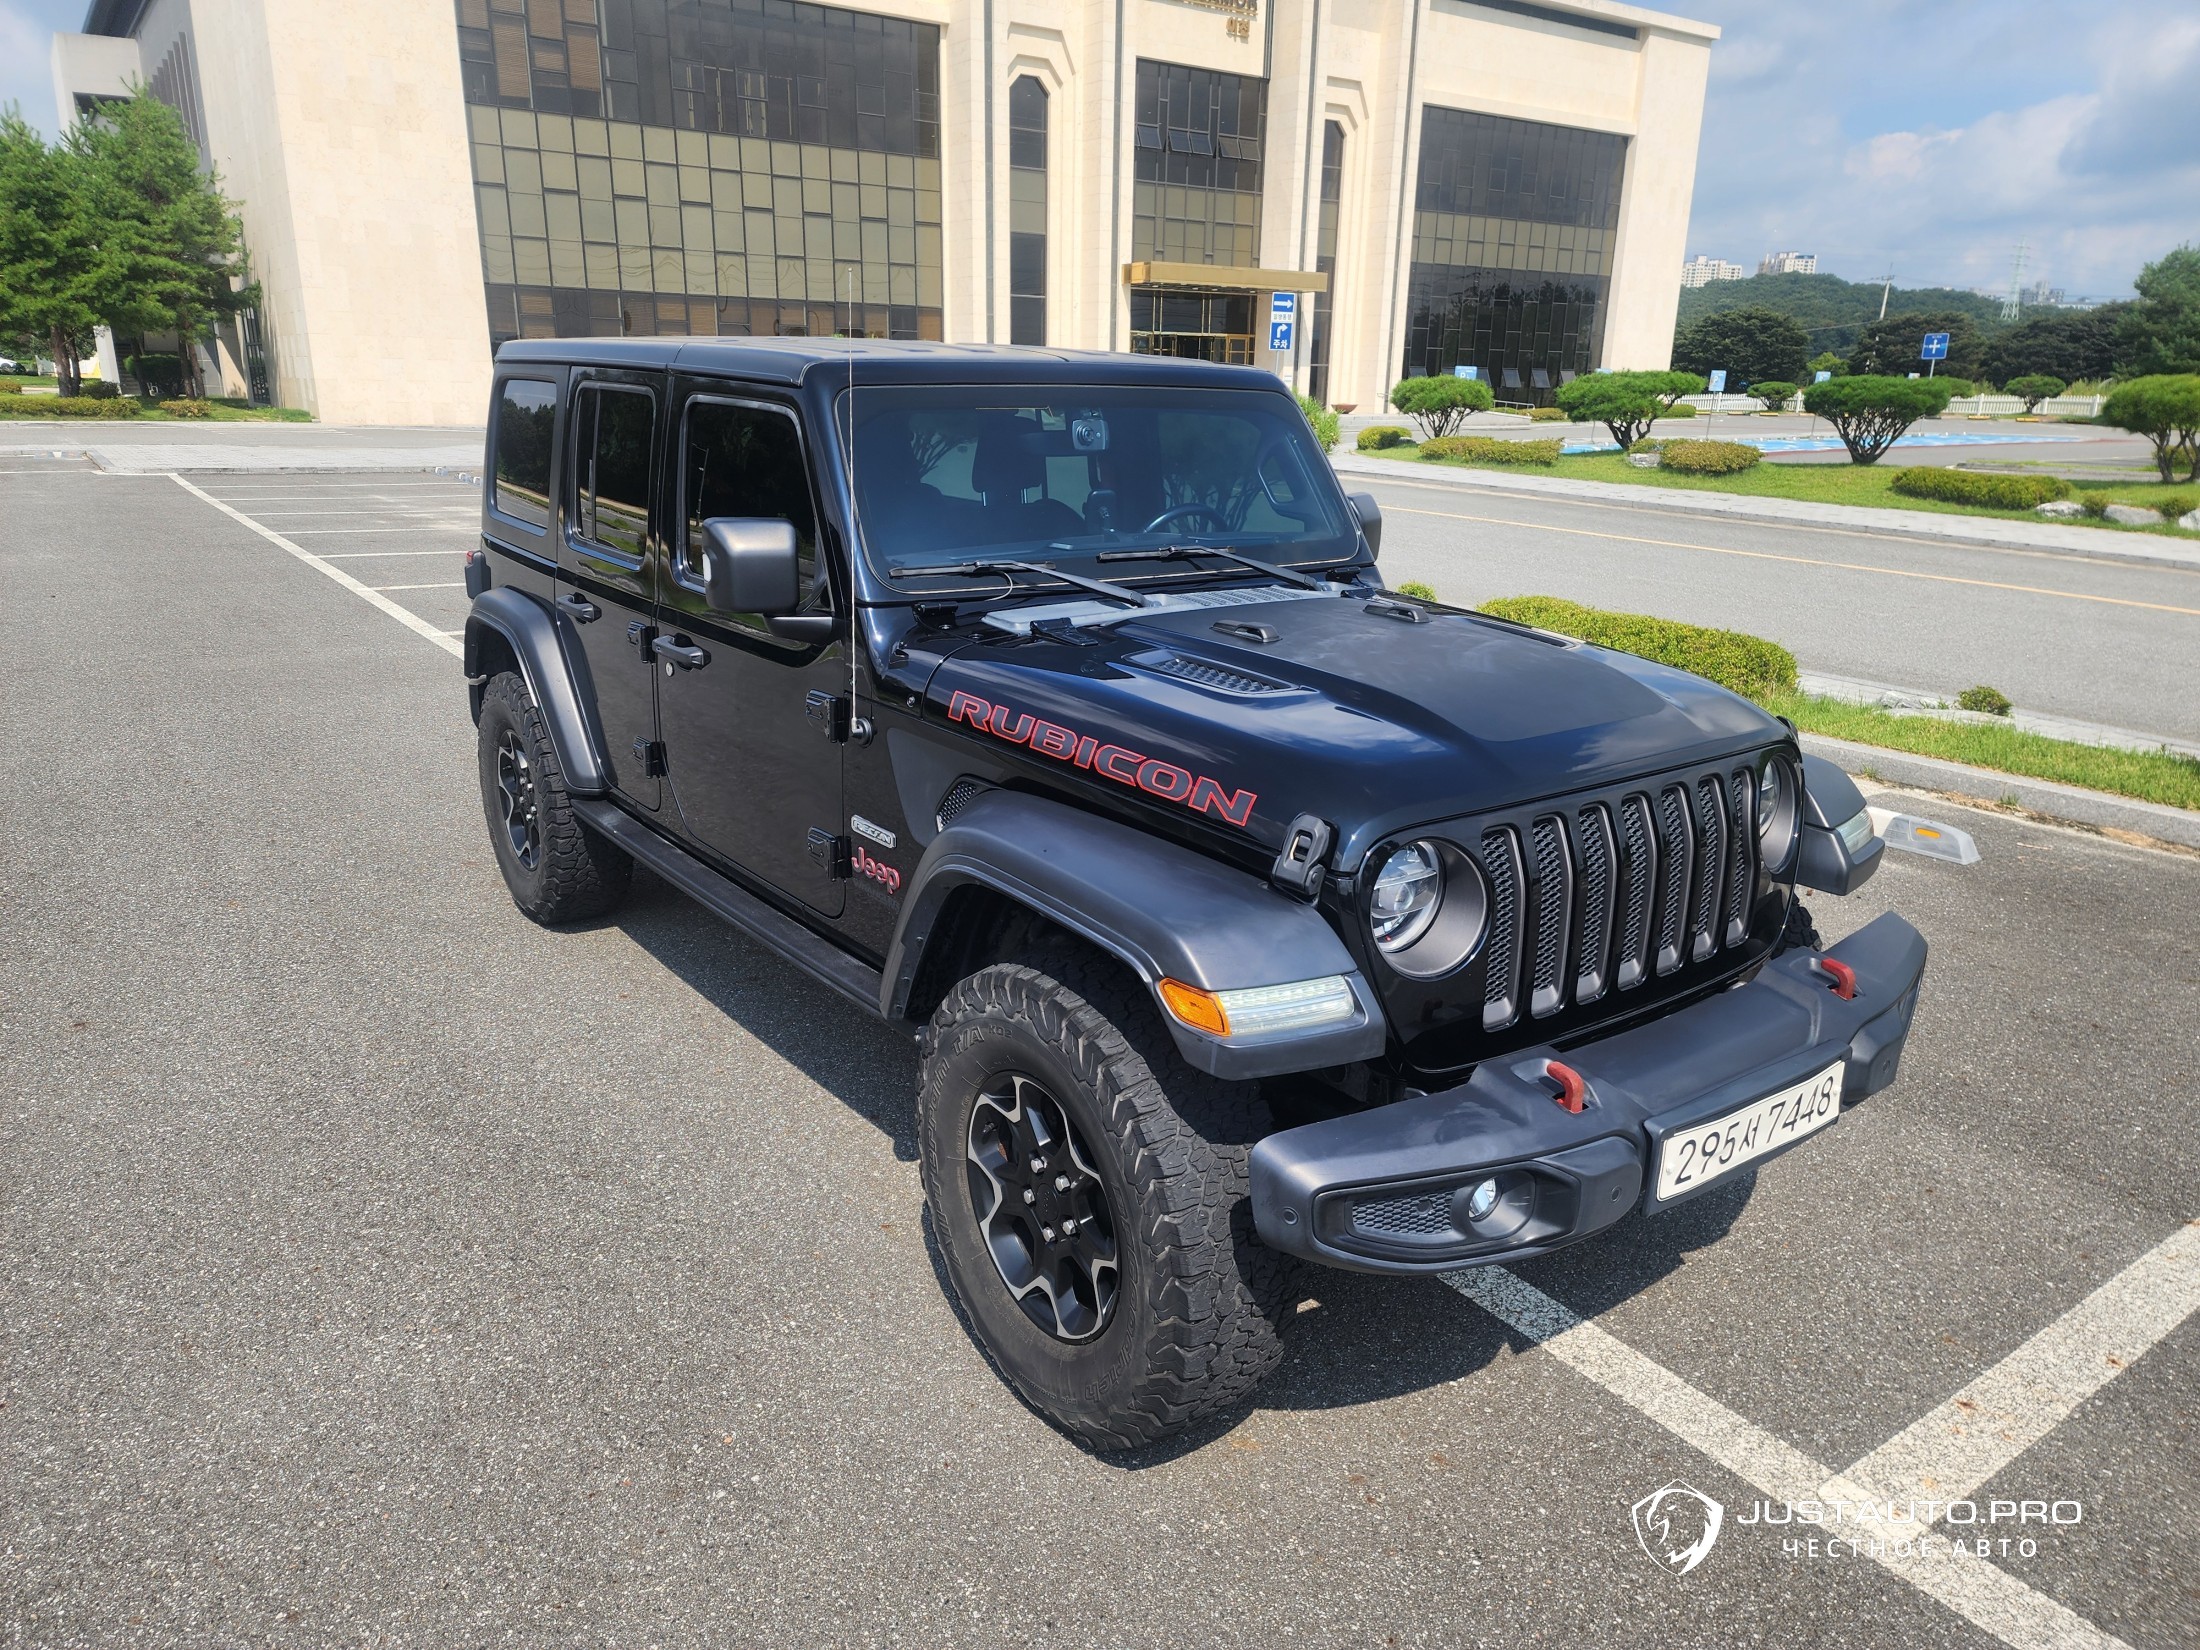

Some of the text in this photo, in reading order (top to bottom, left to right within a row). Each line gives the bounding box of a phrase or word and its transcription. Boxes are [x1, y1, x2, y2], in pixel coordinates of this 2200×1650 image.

[1273, 339, 1288, 349] 주차
[947, 690, 1258, 827] RUBICON
[854, 821, 891, 844] RECON
[851, 846, 900, 894] Jeep
[951, 1025, 985, 1057] T/A
[1766, 1076, 1835, 1145] 7448
